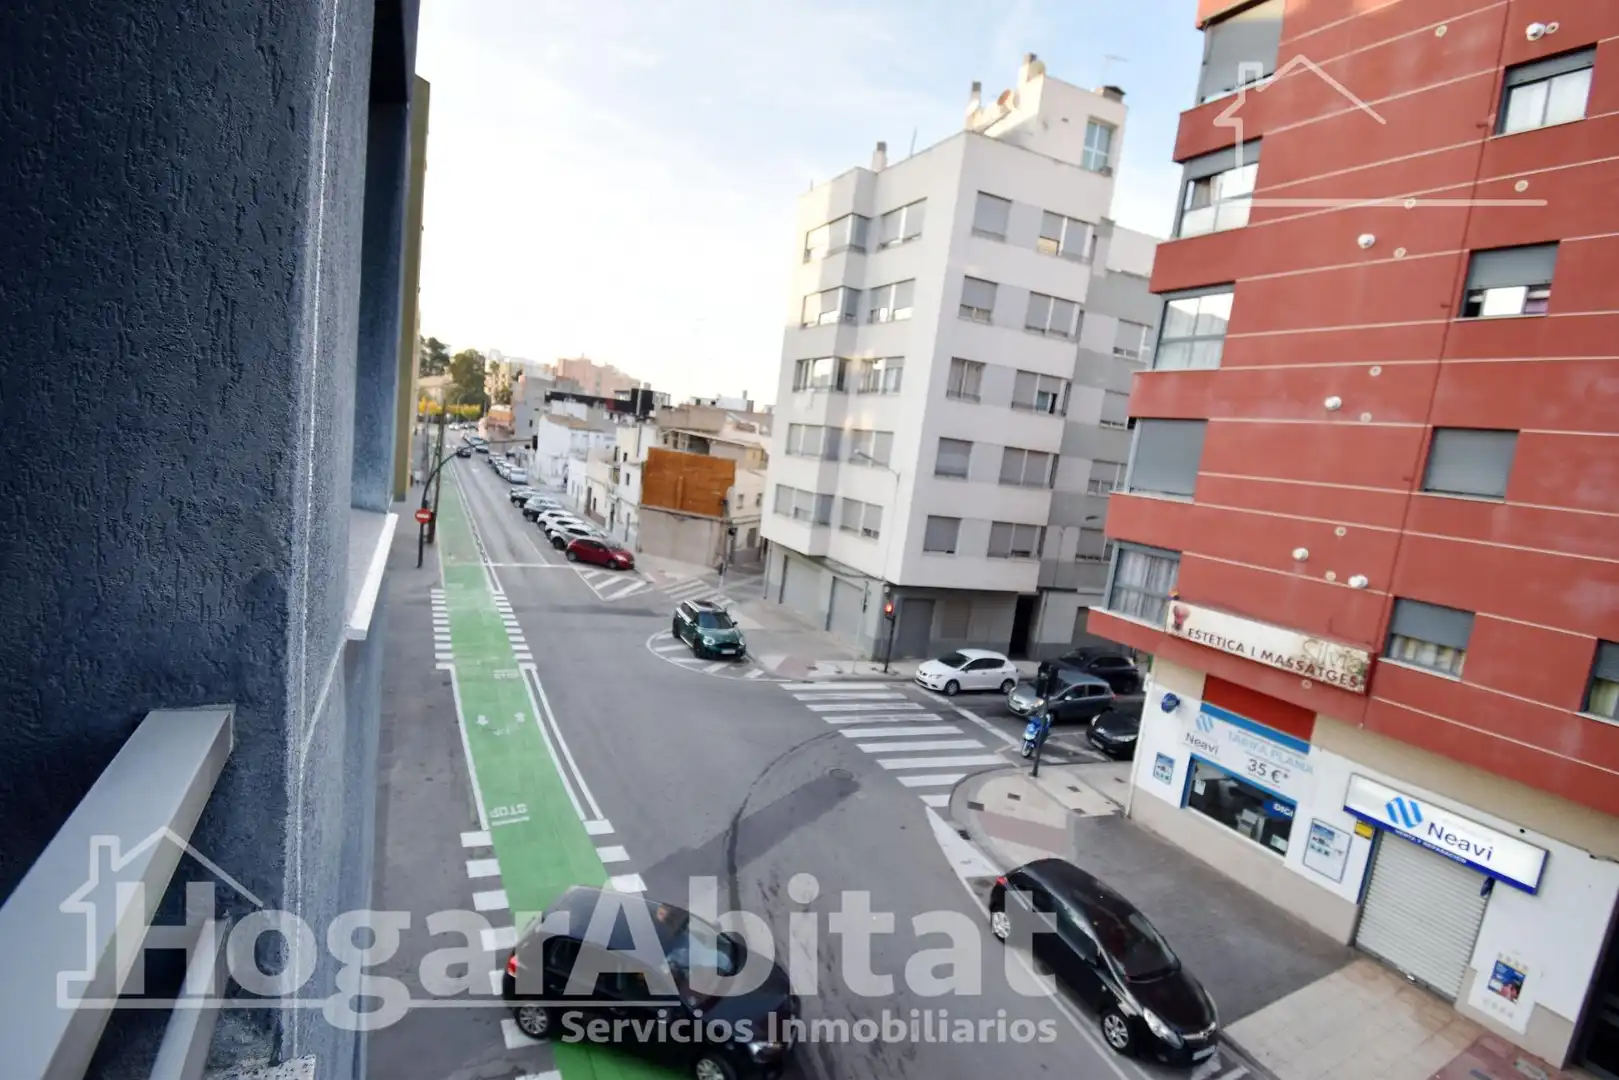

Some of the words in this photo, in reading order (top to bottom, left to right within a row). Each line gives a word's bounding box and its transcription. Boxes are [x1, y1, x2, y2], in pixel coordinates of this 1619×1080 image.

[1188, 628, 1245, 653] ESTETICA
[1261, 650, 1358, 687] MASSATGES
[1185, 732, 1219, 756] Neavi
[1247, 759, 1267, 777] 35
[1427, 821, 1494, 861] Neavi
